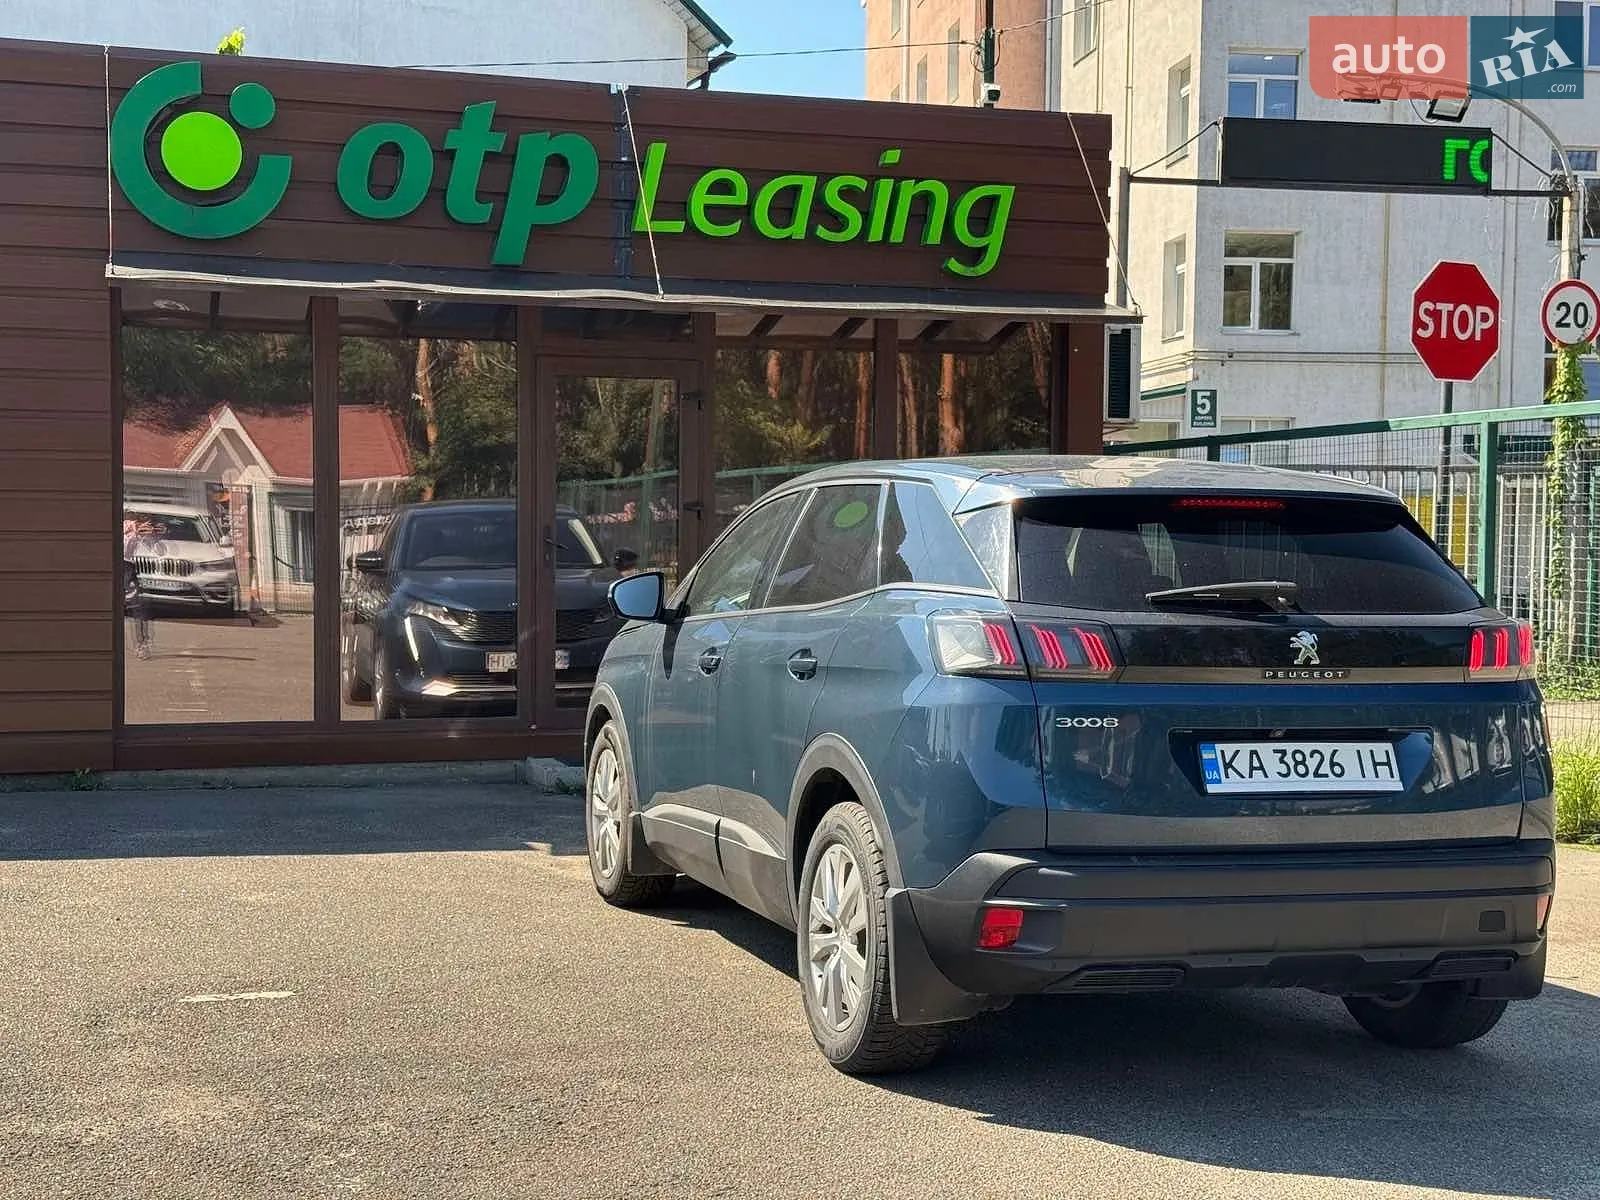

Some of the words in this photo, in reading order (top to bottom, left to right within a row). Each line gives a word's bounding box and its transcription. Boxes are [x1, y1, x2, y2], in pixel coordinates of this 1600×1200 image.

[336, 101, 600, 265] otp
[632, 142, 1016, 277] Leasing
[1416, 301, 1495, 342] STOP
[1555, 302, 1589, 329] 20
[1196, 391, 1211, 415] 5
[1265, 671, 1346, 679] PEUGEOT
[1055, 717, 1120, 728] 3008
[1205, 771, 1220, 780] UA
[1220, 749, 1270, 779] KA
[1272, 749, 1346, 779] 3826
[1356, 749, 1396, 779] IH
